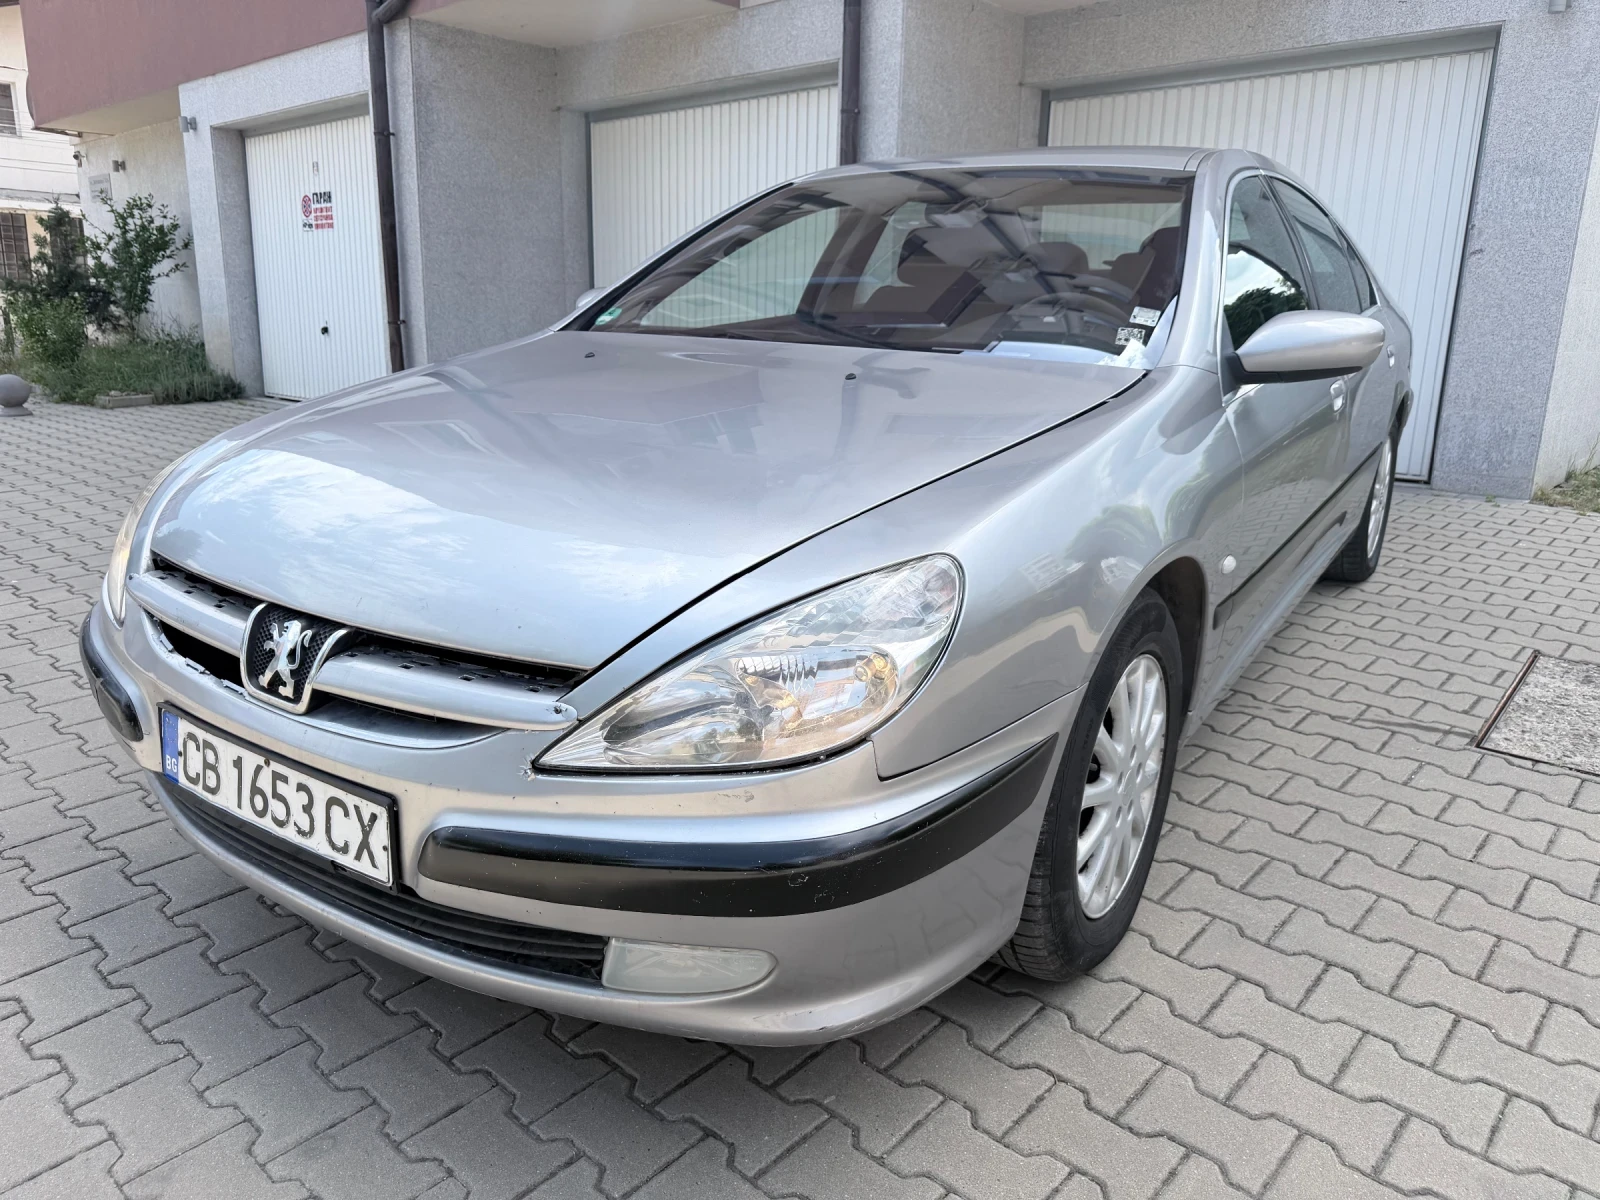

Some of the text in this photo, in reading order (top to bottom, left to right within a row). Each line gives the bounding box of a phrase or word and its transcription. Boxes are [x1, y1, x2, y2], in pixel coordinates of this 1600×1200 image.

[165, 754, 178, 773] BG
[182, 732, 379, 870] CB 1653 CX
